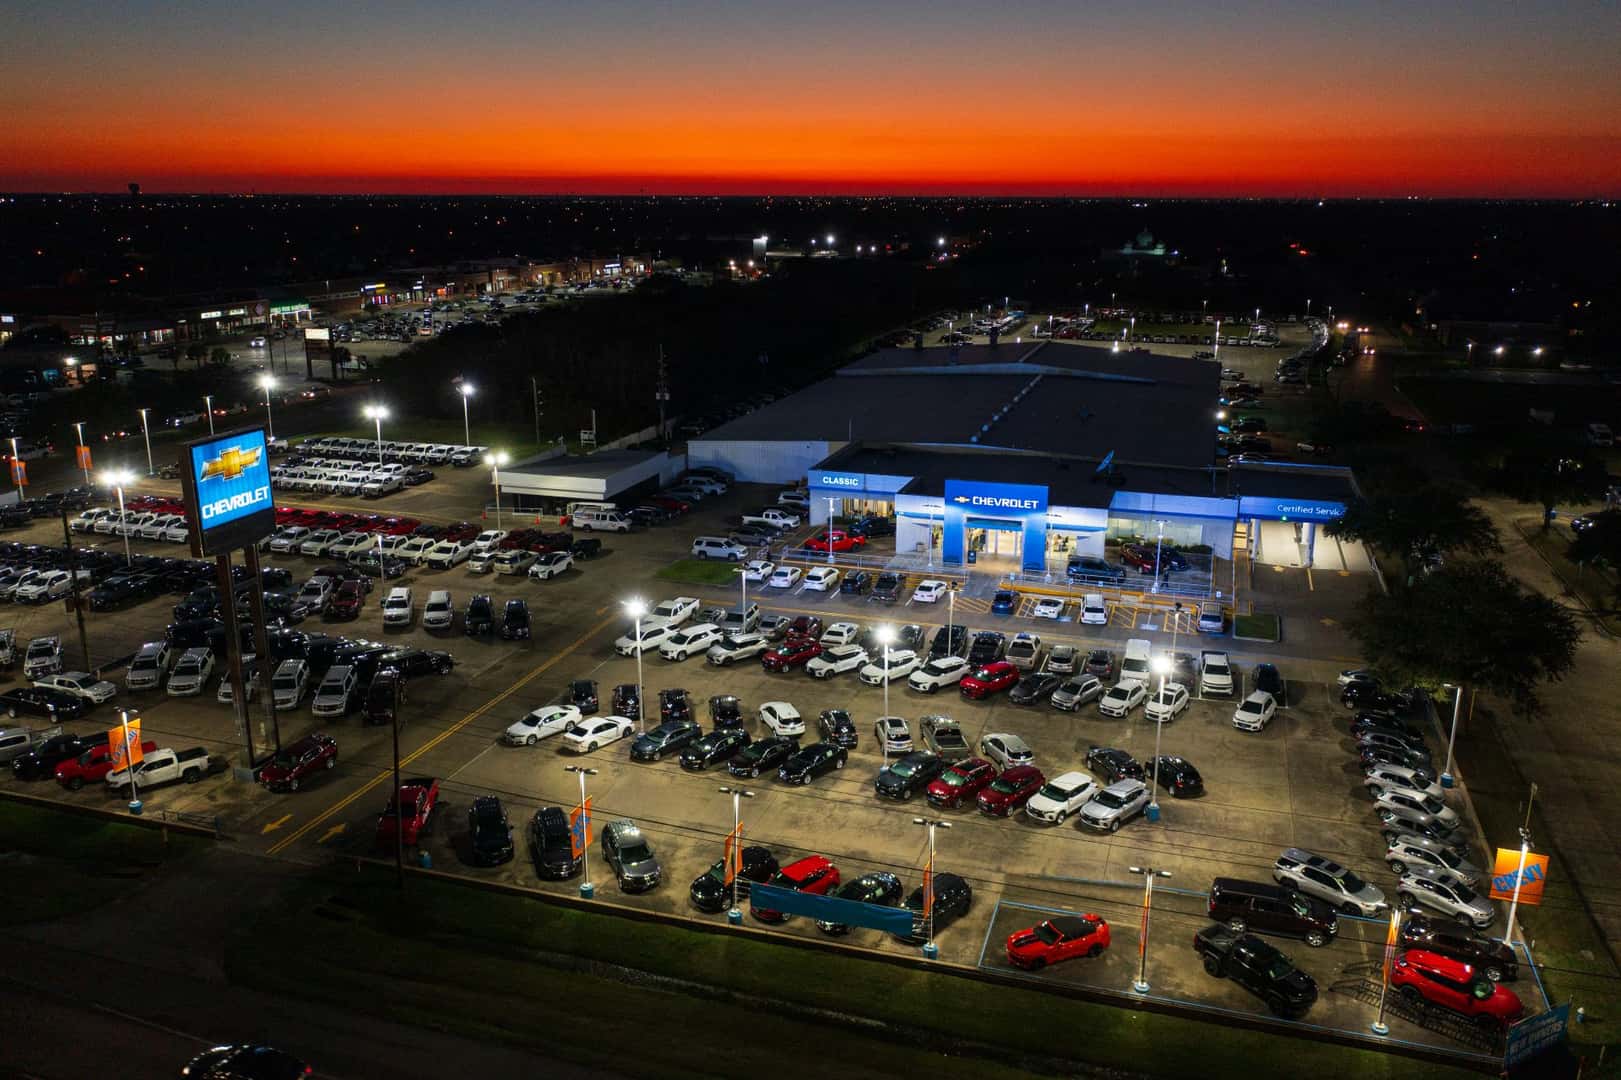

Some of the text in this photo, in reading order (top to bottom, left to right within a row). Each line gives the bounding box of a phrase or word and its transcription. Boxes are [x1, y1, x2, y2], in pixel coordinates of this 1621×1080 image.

[823, 476, 859, 486] CLASSIC
[202, 486, 269, 519] CHEVROLET
[972, 496, 1039, 510] CHEVROLET
[1277, 504, 1313, 514] Certified
